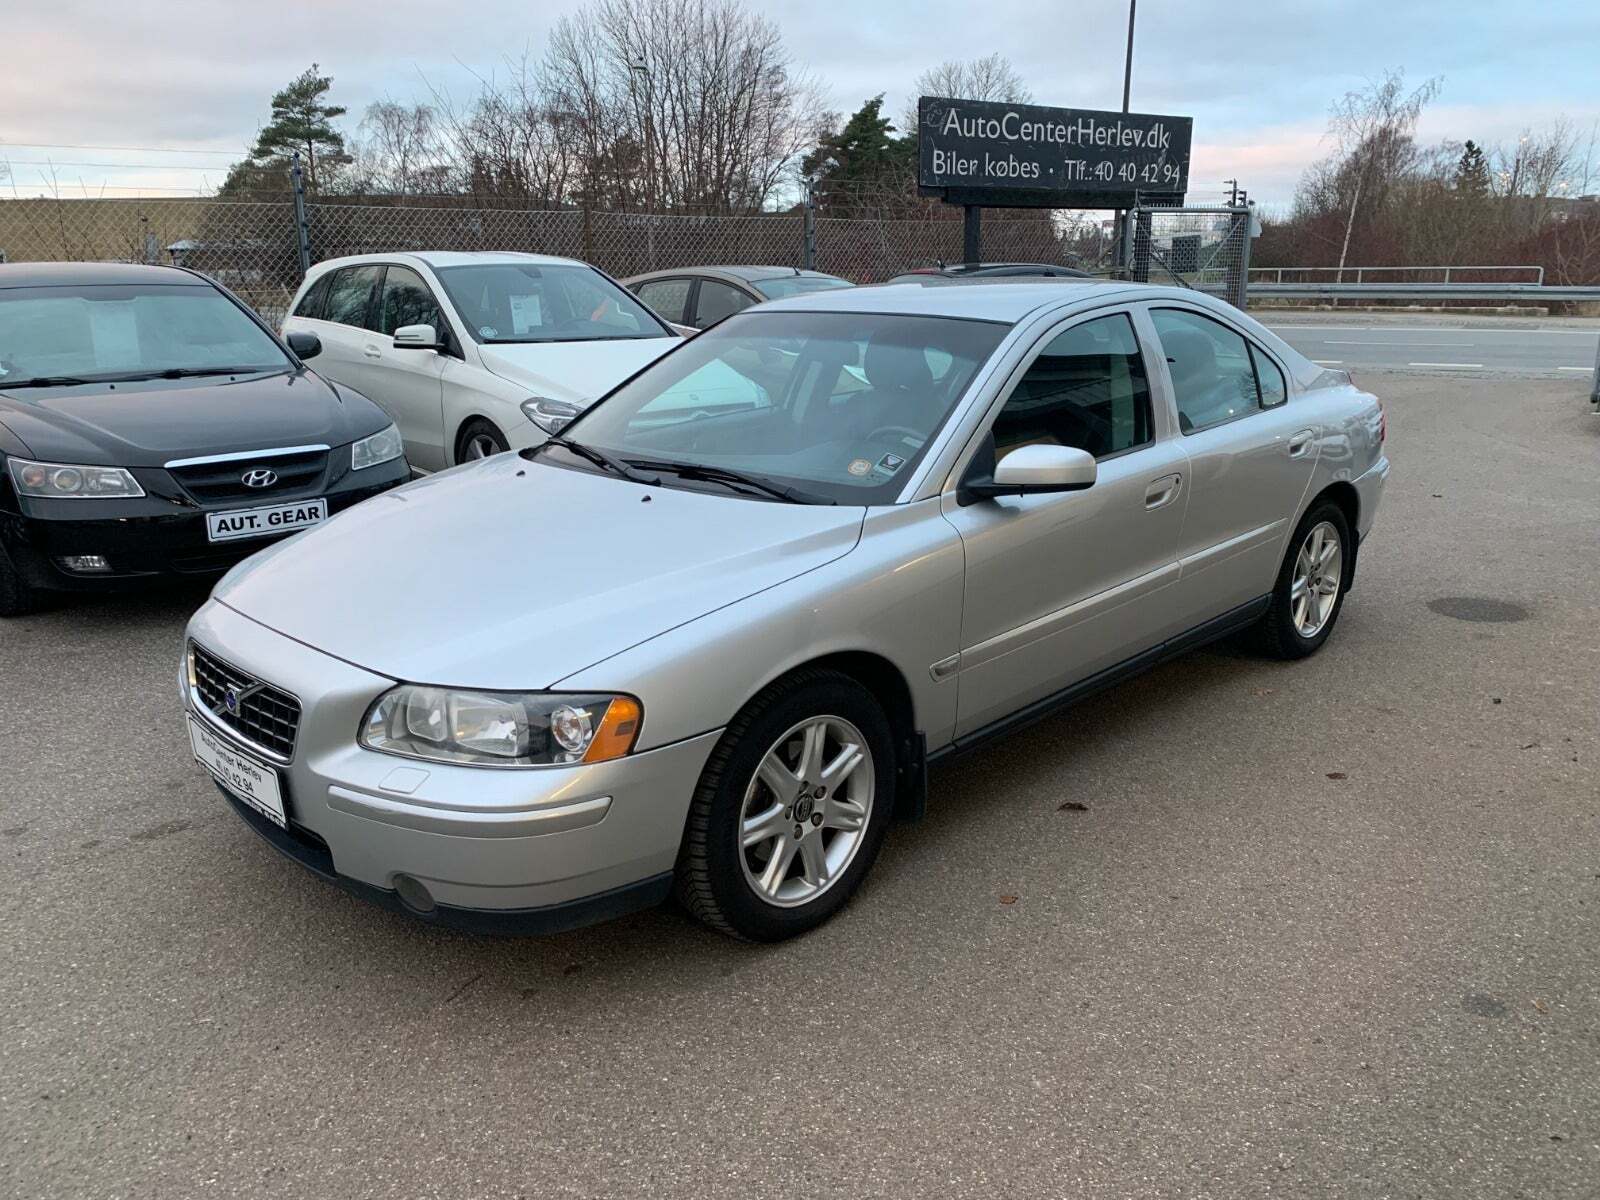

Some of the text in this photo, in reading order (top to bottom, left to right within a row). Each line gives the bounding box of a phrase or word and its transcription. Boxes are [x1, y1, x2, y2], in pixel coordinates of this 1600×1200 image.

[933, 149, 977, 176] Biler
[984, 152, 1040, 178] købes
[1118, 161, 1137, 182] 40
[1141, 163, 1158, 183] 42
[1164, 164, 1180, 186] 94
[217, 507, 320, 533] AUT. GEAR
